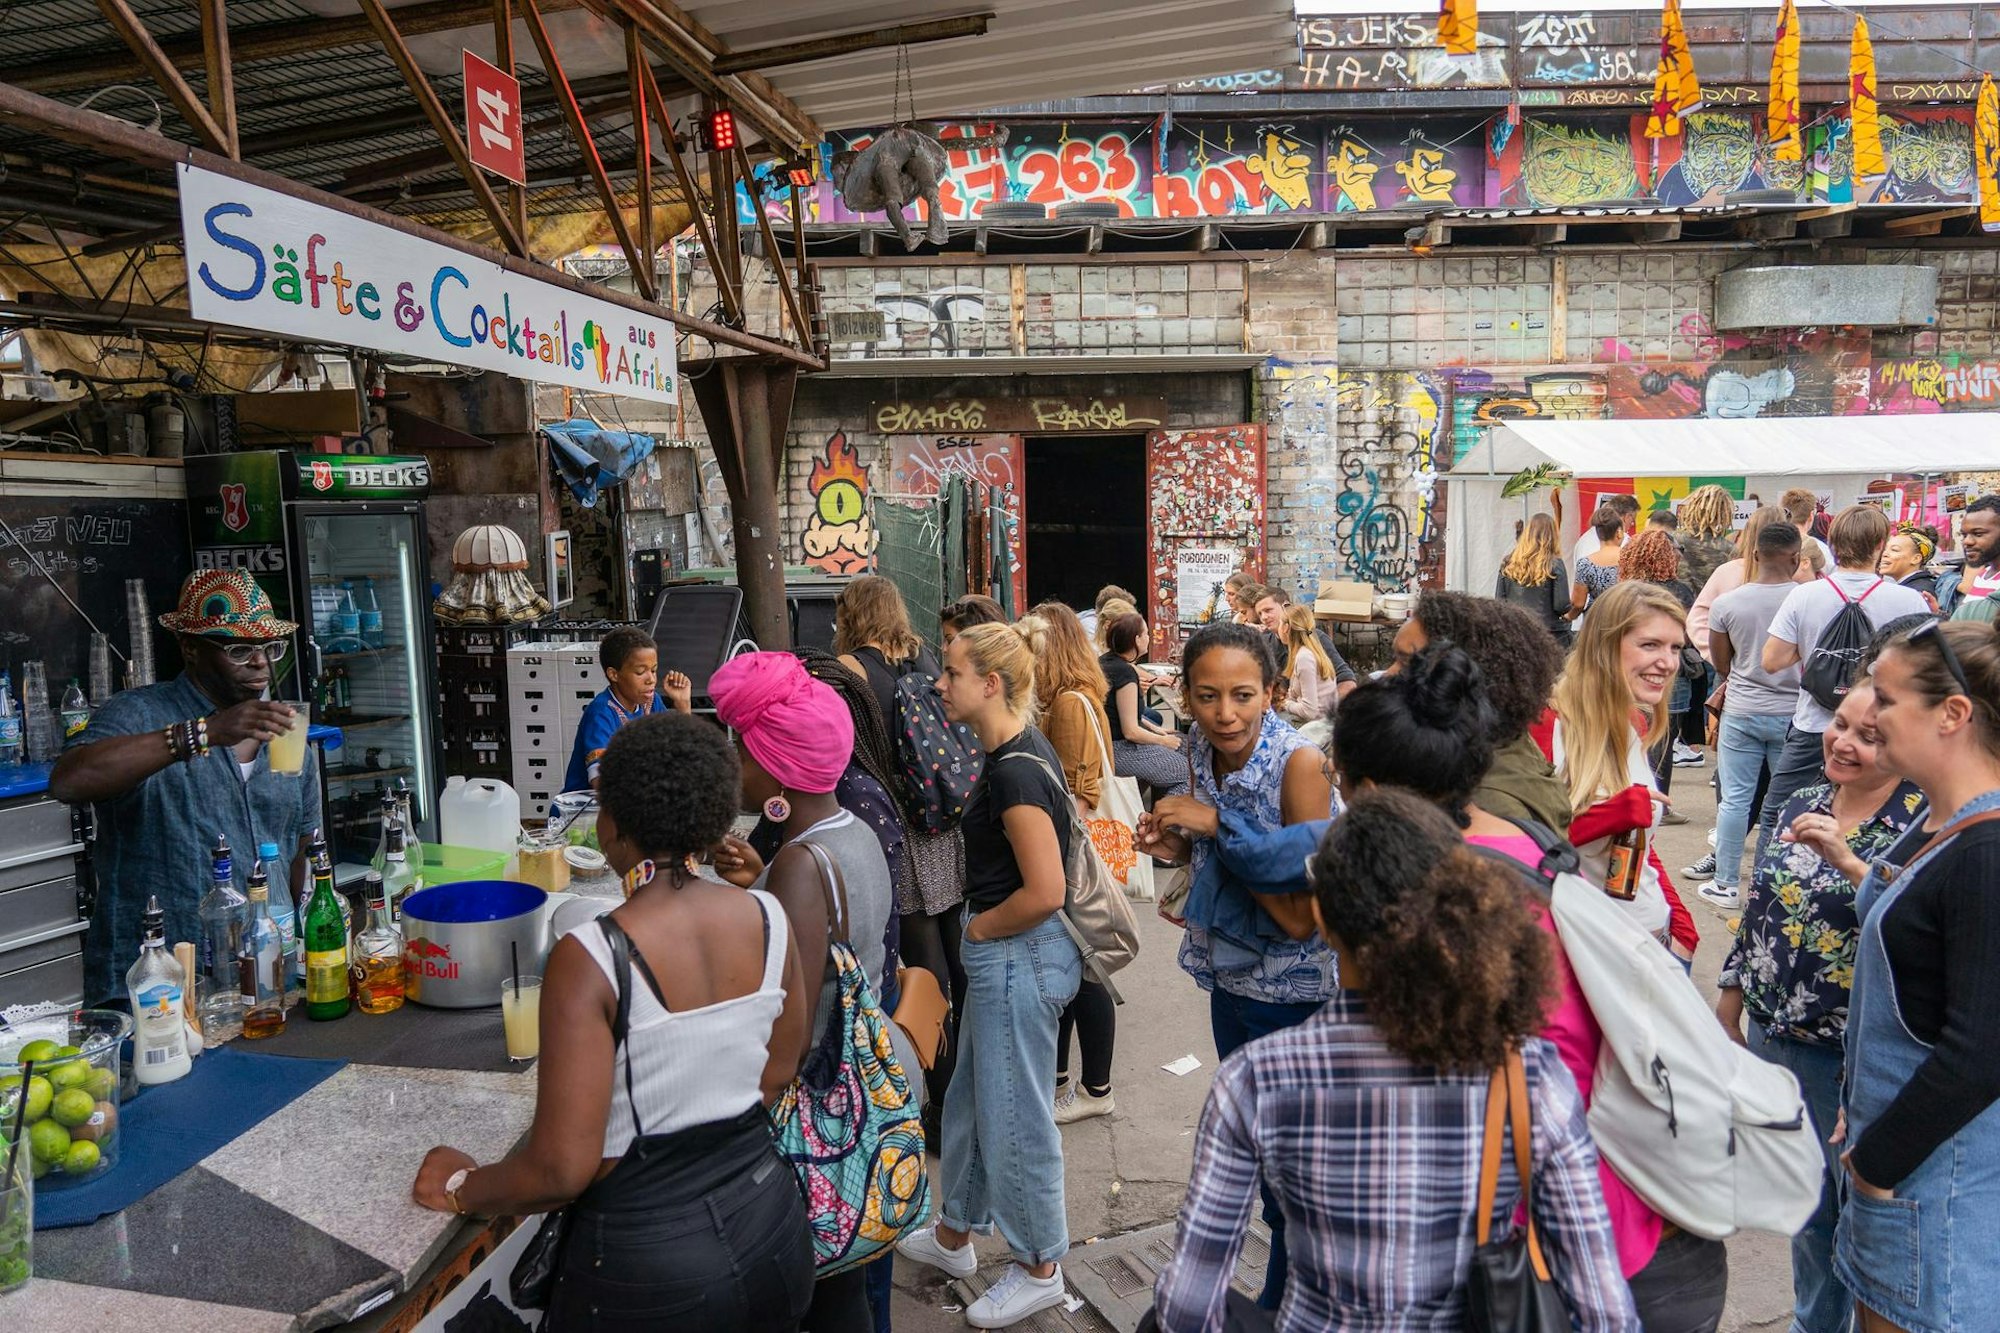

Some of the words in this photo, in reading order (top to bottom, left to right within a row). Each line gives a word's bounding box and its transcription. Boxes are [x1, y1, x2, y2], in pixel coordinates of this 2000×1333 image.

[476, 86, 512, 151] 14
[1021, 135, 1136, 202] 263
[198, 202, 382, 320] Säfte
[394, 281, 424, 332] &
[430, 265, 584, 370] Cocktails
[628, 325, 656, 349] aus
[834, 316, 882, 338] Holzweg
[615, 345, 673, 393] Afrika
[935, 436, 982, 450] ESEL
[348, 467, 428, 488] BECK'S
[65, 514, 131, 545] NEU
[195, 544, 285, 572] BECK'S
[425, 961, 458, 979] Bull
